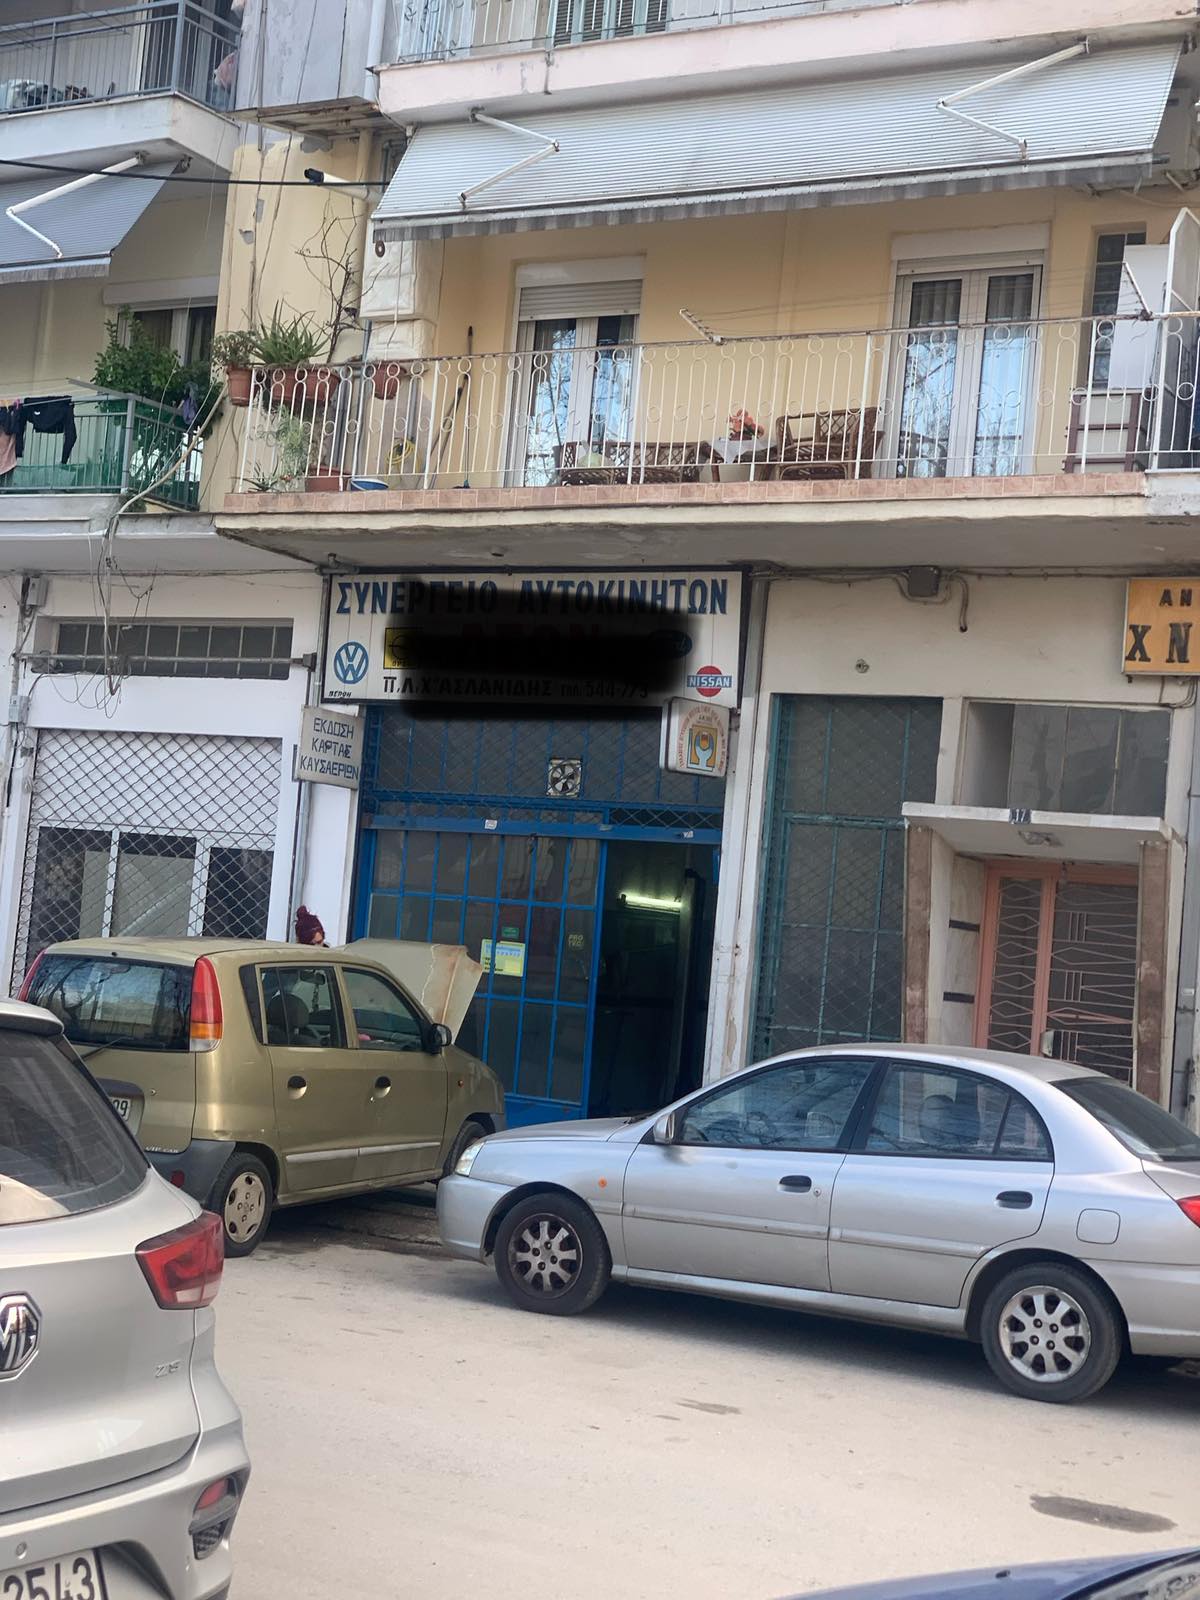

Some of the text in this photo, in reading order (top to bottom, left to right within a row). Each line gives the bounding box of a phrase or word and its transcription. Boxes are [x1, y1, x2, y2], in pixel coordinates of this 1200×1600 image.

[336, 577, 728, 615] ΣΥΝΕΡΓΕΙΟ ΑΥΤΟΚΙΝΗΤΩΝ
[688, 674, 732, 689] NISSAN
[313, 717, 355, 739] ΕΚΔΟΣΗ
[311, 737, 353, 759] ΚΑΡΤΑΣ
[300, 755, 360, 780] ΚΑΥΣΑΕΡΙΩΝ
